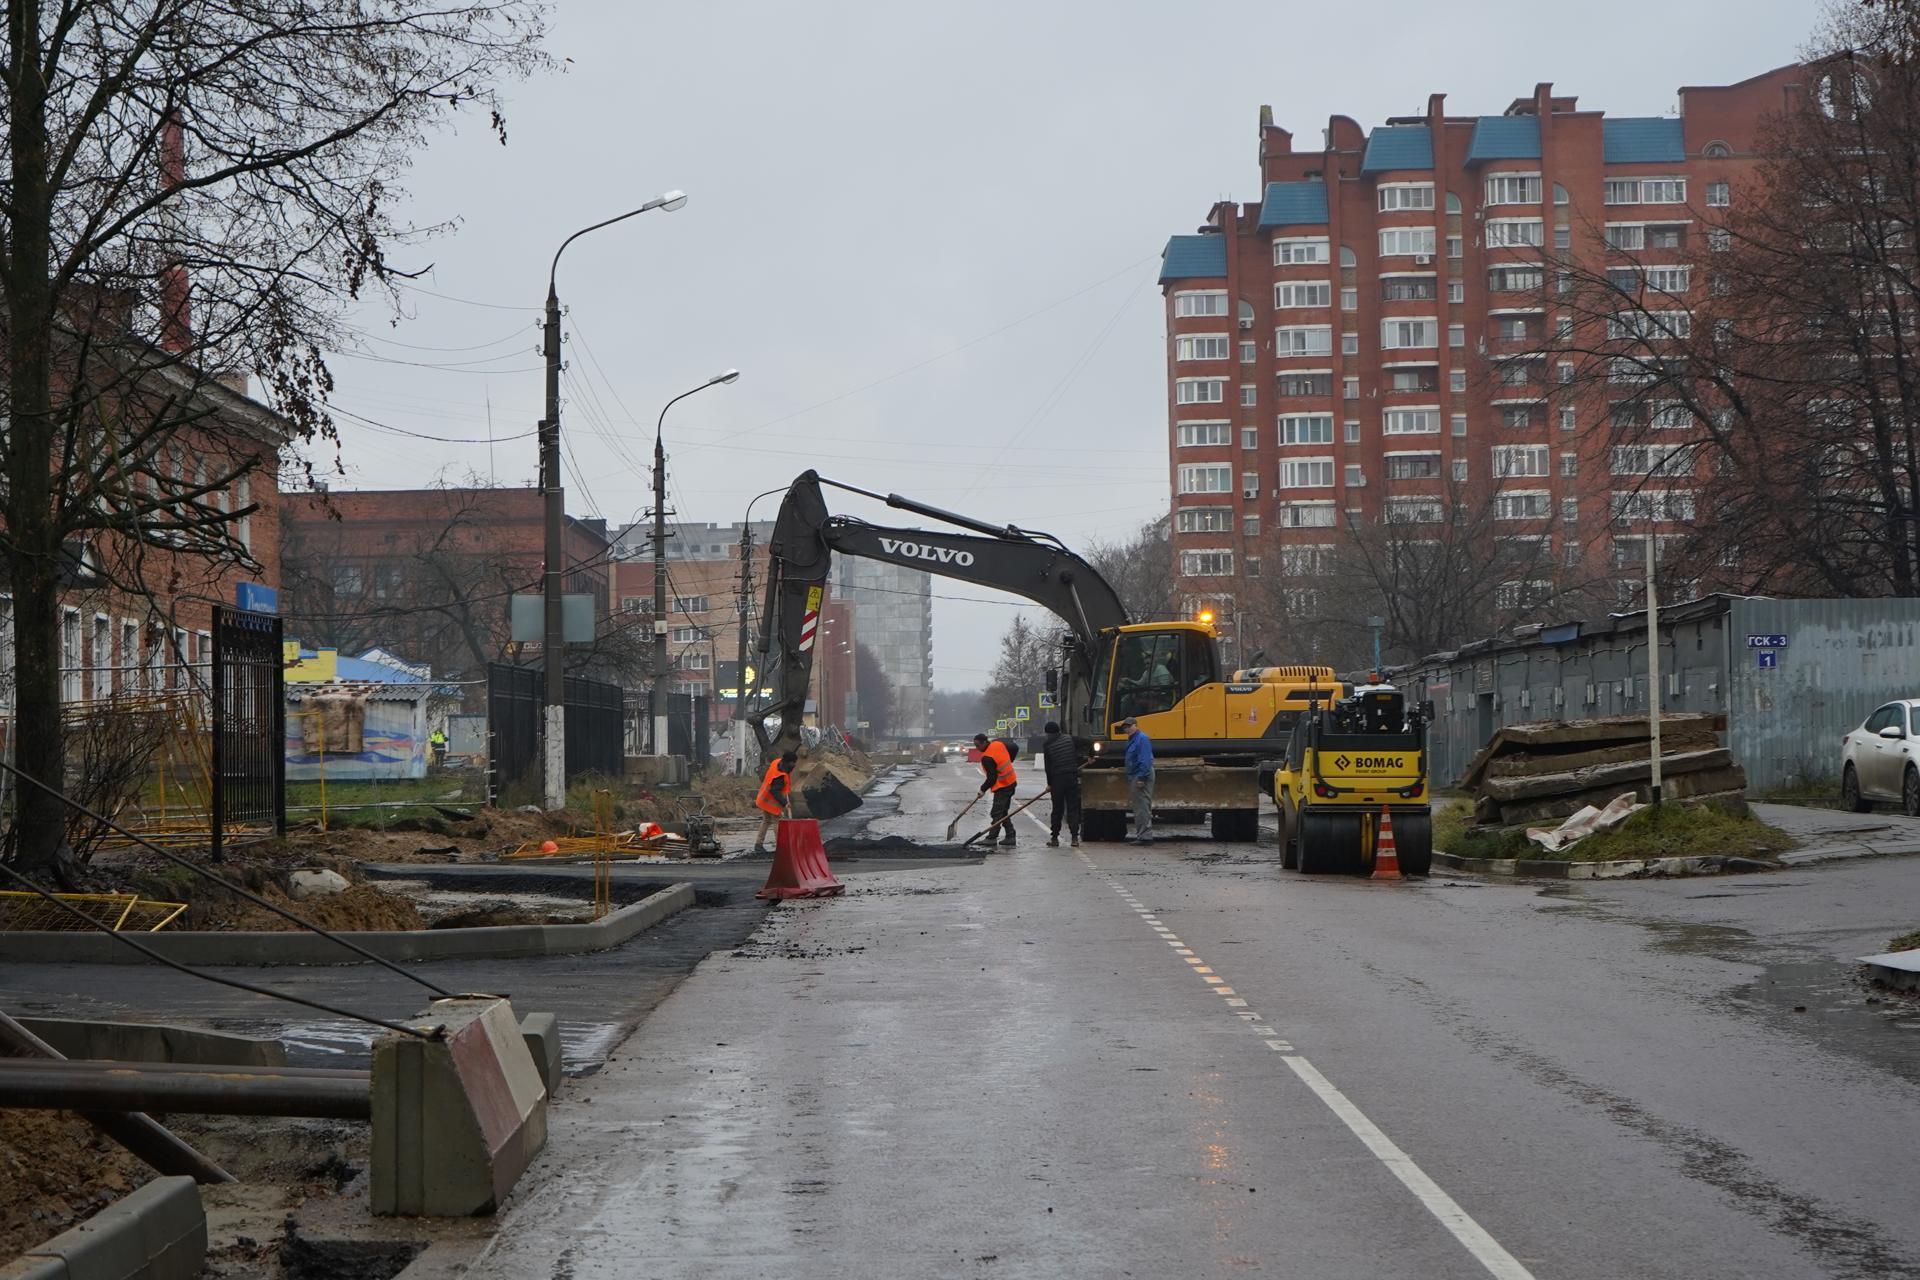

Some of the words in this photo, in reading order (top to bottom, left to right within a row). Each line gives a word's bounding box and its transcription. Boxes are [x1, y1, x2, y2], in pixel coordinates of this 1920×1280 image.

[878, 537, 974, 567] VOLVO
[1748, 636, 1770, 646] ГСК
[1779, 636, 1786, 646] 3
[1764, 655, 1771, 667] 1
[1355, 757, 1404, 769] BOMAG
